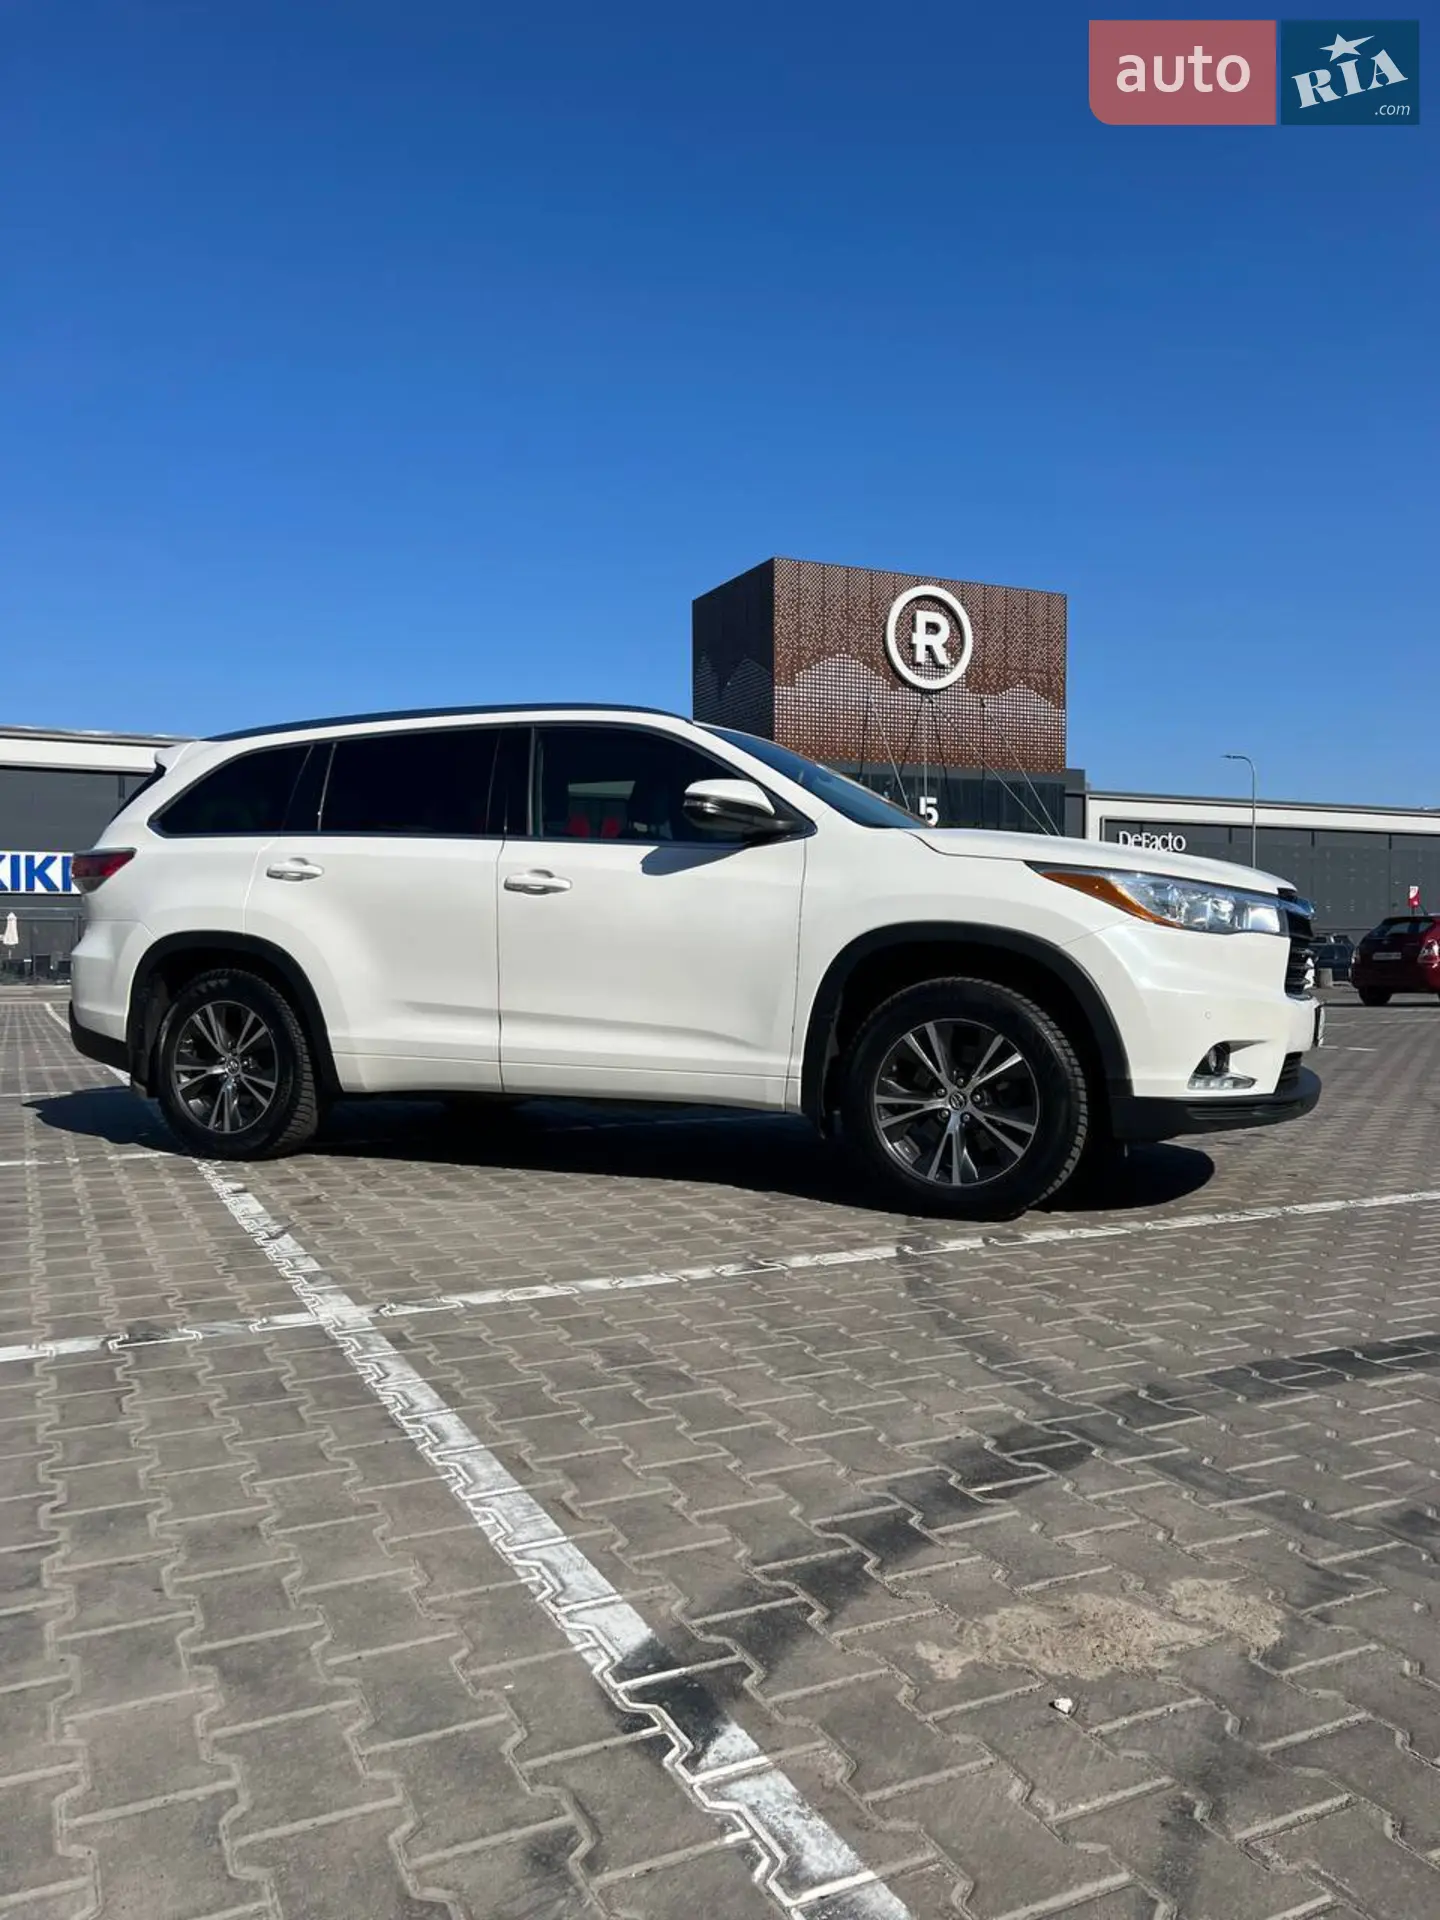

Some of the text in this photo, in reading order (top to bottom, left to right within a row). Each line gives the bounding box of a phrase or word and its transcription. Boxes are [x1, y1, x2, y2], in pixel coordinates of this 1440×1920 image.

[919, 796, 939, 827] 5
[1119, 830, 1186, 852] DeFacto
[0, 854, 72, 892] IKI
